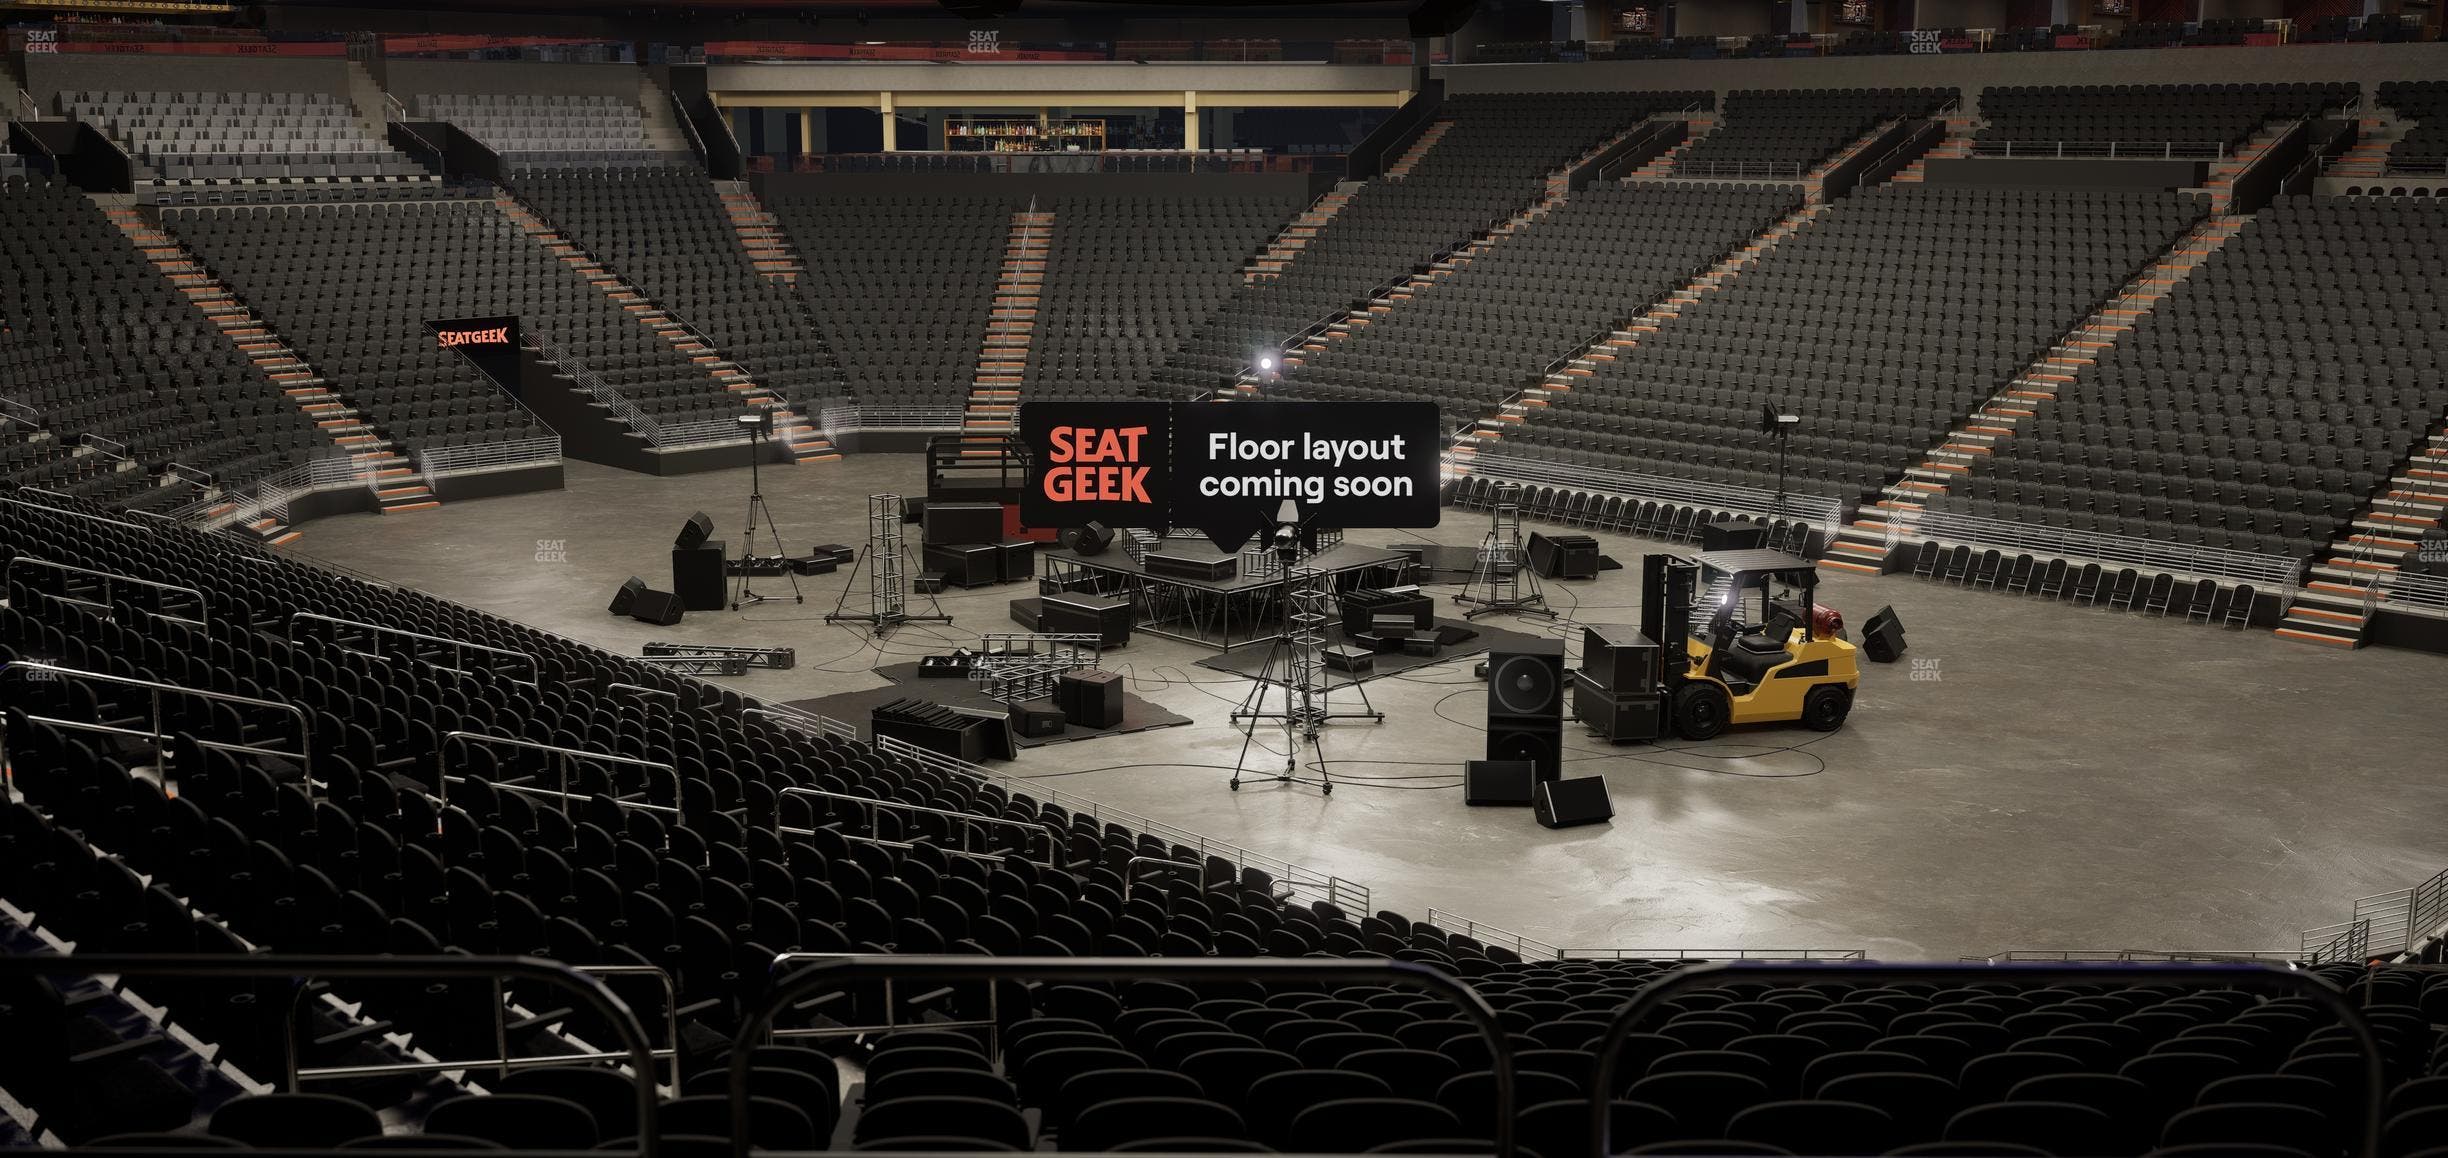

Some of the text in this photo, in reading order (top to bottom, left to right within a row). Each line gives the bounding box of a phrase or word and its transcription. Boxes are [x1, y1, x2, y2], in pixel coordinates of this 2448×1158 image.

[438, 327, 509, 347] SEATGEEK
[1050, 426, 1148, 463] SEAT
[1209, 432, 1405, 467] Floor layout
[1044, 467, 1152, 504] GEEK
[1200, 469, 1413, 503] coming soon
